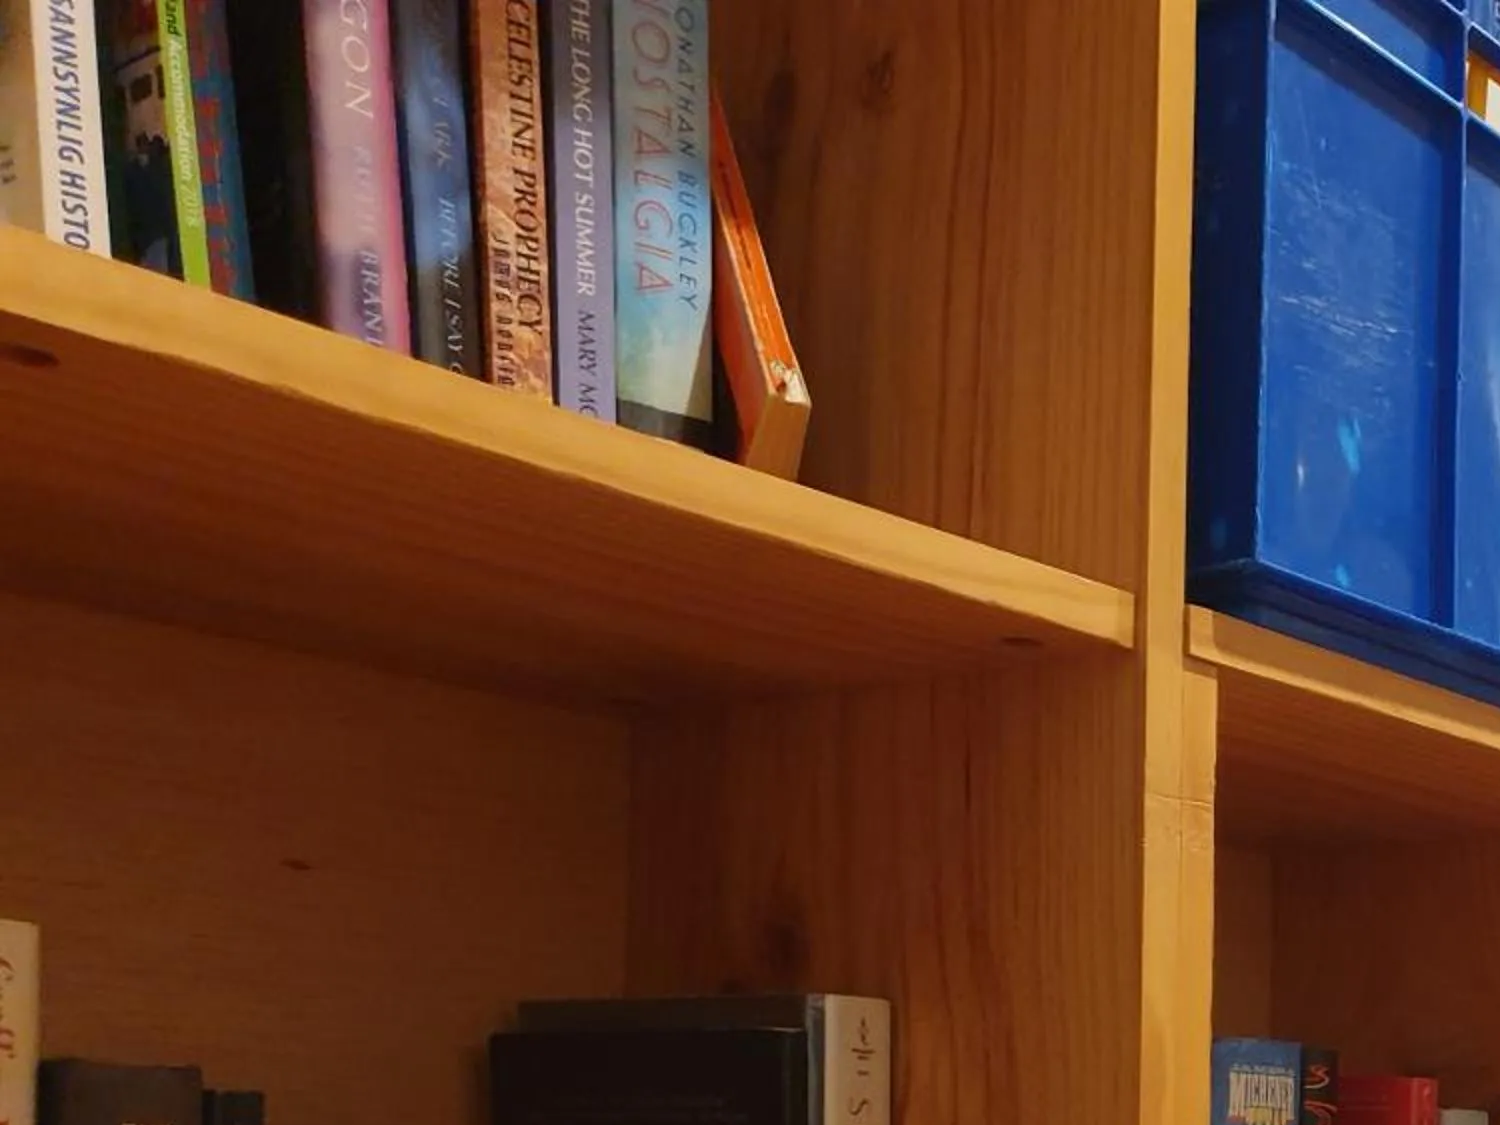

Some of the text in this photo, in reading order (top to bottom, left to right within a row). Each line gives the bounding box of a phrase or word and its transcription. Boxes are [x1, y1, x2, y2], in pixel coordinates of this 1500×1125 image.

[572, 0, 592, 43] THE
[168, 38, 195, 181] Accommodation
[570, 47, 594, 122] LONG
[506, 0, 544, 336] CELESTINE PROPHECY
[573, 125, 594, 189] HOT
[60, 169, 92, 250] HISTO
[573, 191, 597, 297] SUMMER
[676, 170, 699, 310] BUCKLEY
[446, 312, 467, 356] SAY
[575, 311, 598, 376] MARY
